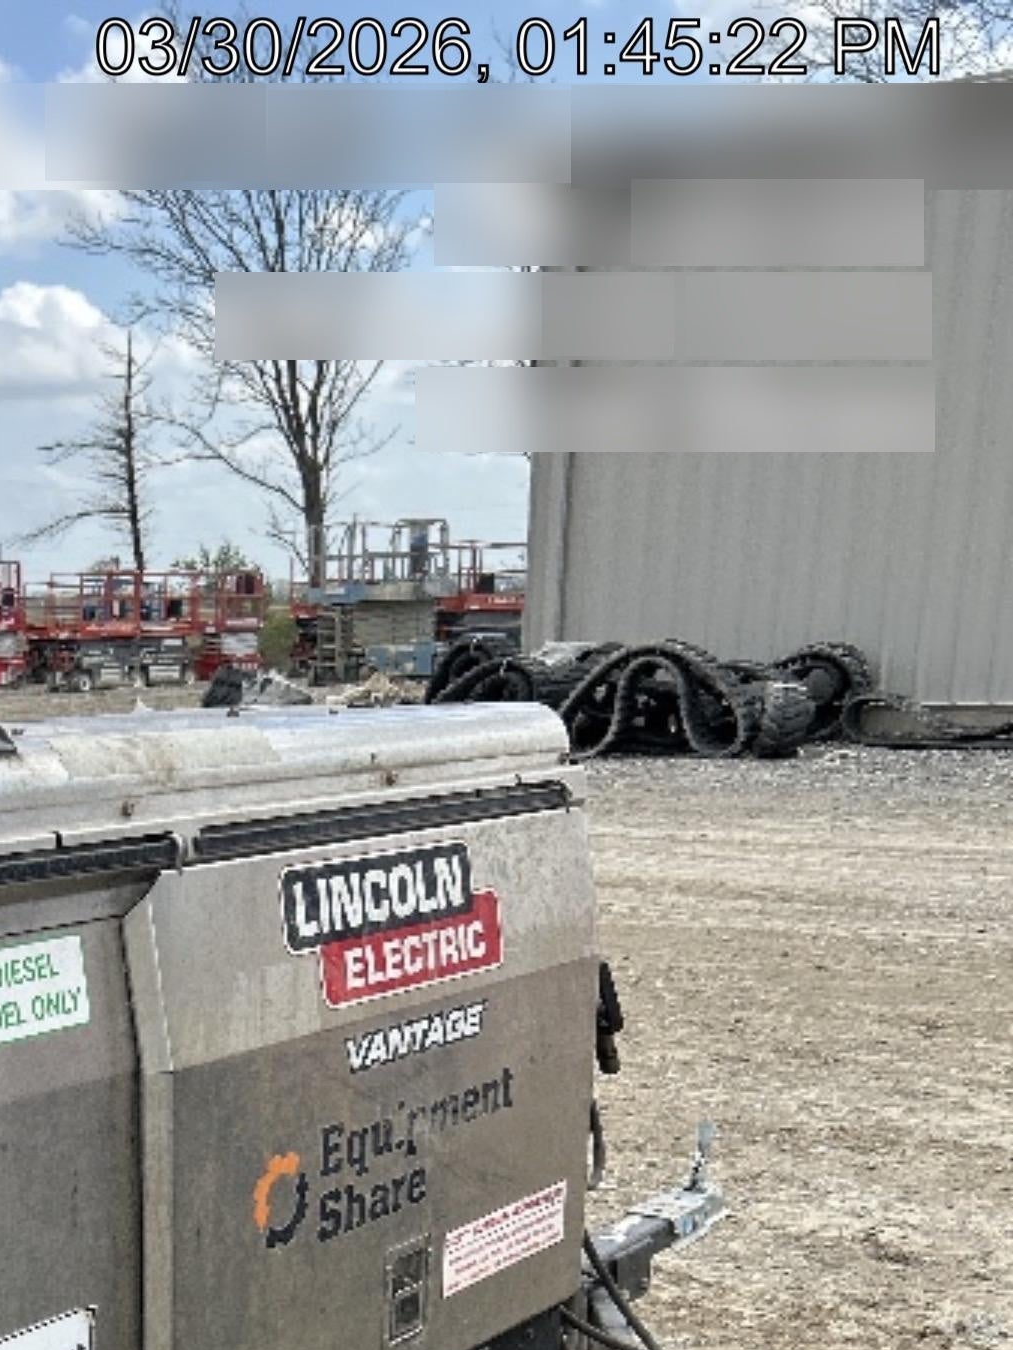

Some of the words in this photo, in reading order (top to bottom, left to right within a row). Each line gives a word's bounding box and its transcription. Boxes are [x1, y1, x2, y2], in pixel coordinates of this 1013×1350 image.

[292, 854, 466, 937] LINCOLN
[343, 919, 486, 989] ELECTRIC
[30, 986, 82, 1022] ONLY
[345, 1002, 486, 1073] VANTAGE
[317, 1166, 427, 1242] Share
